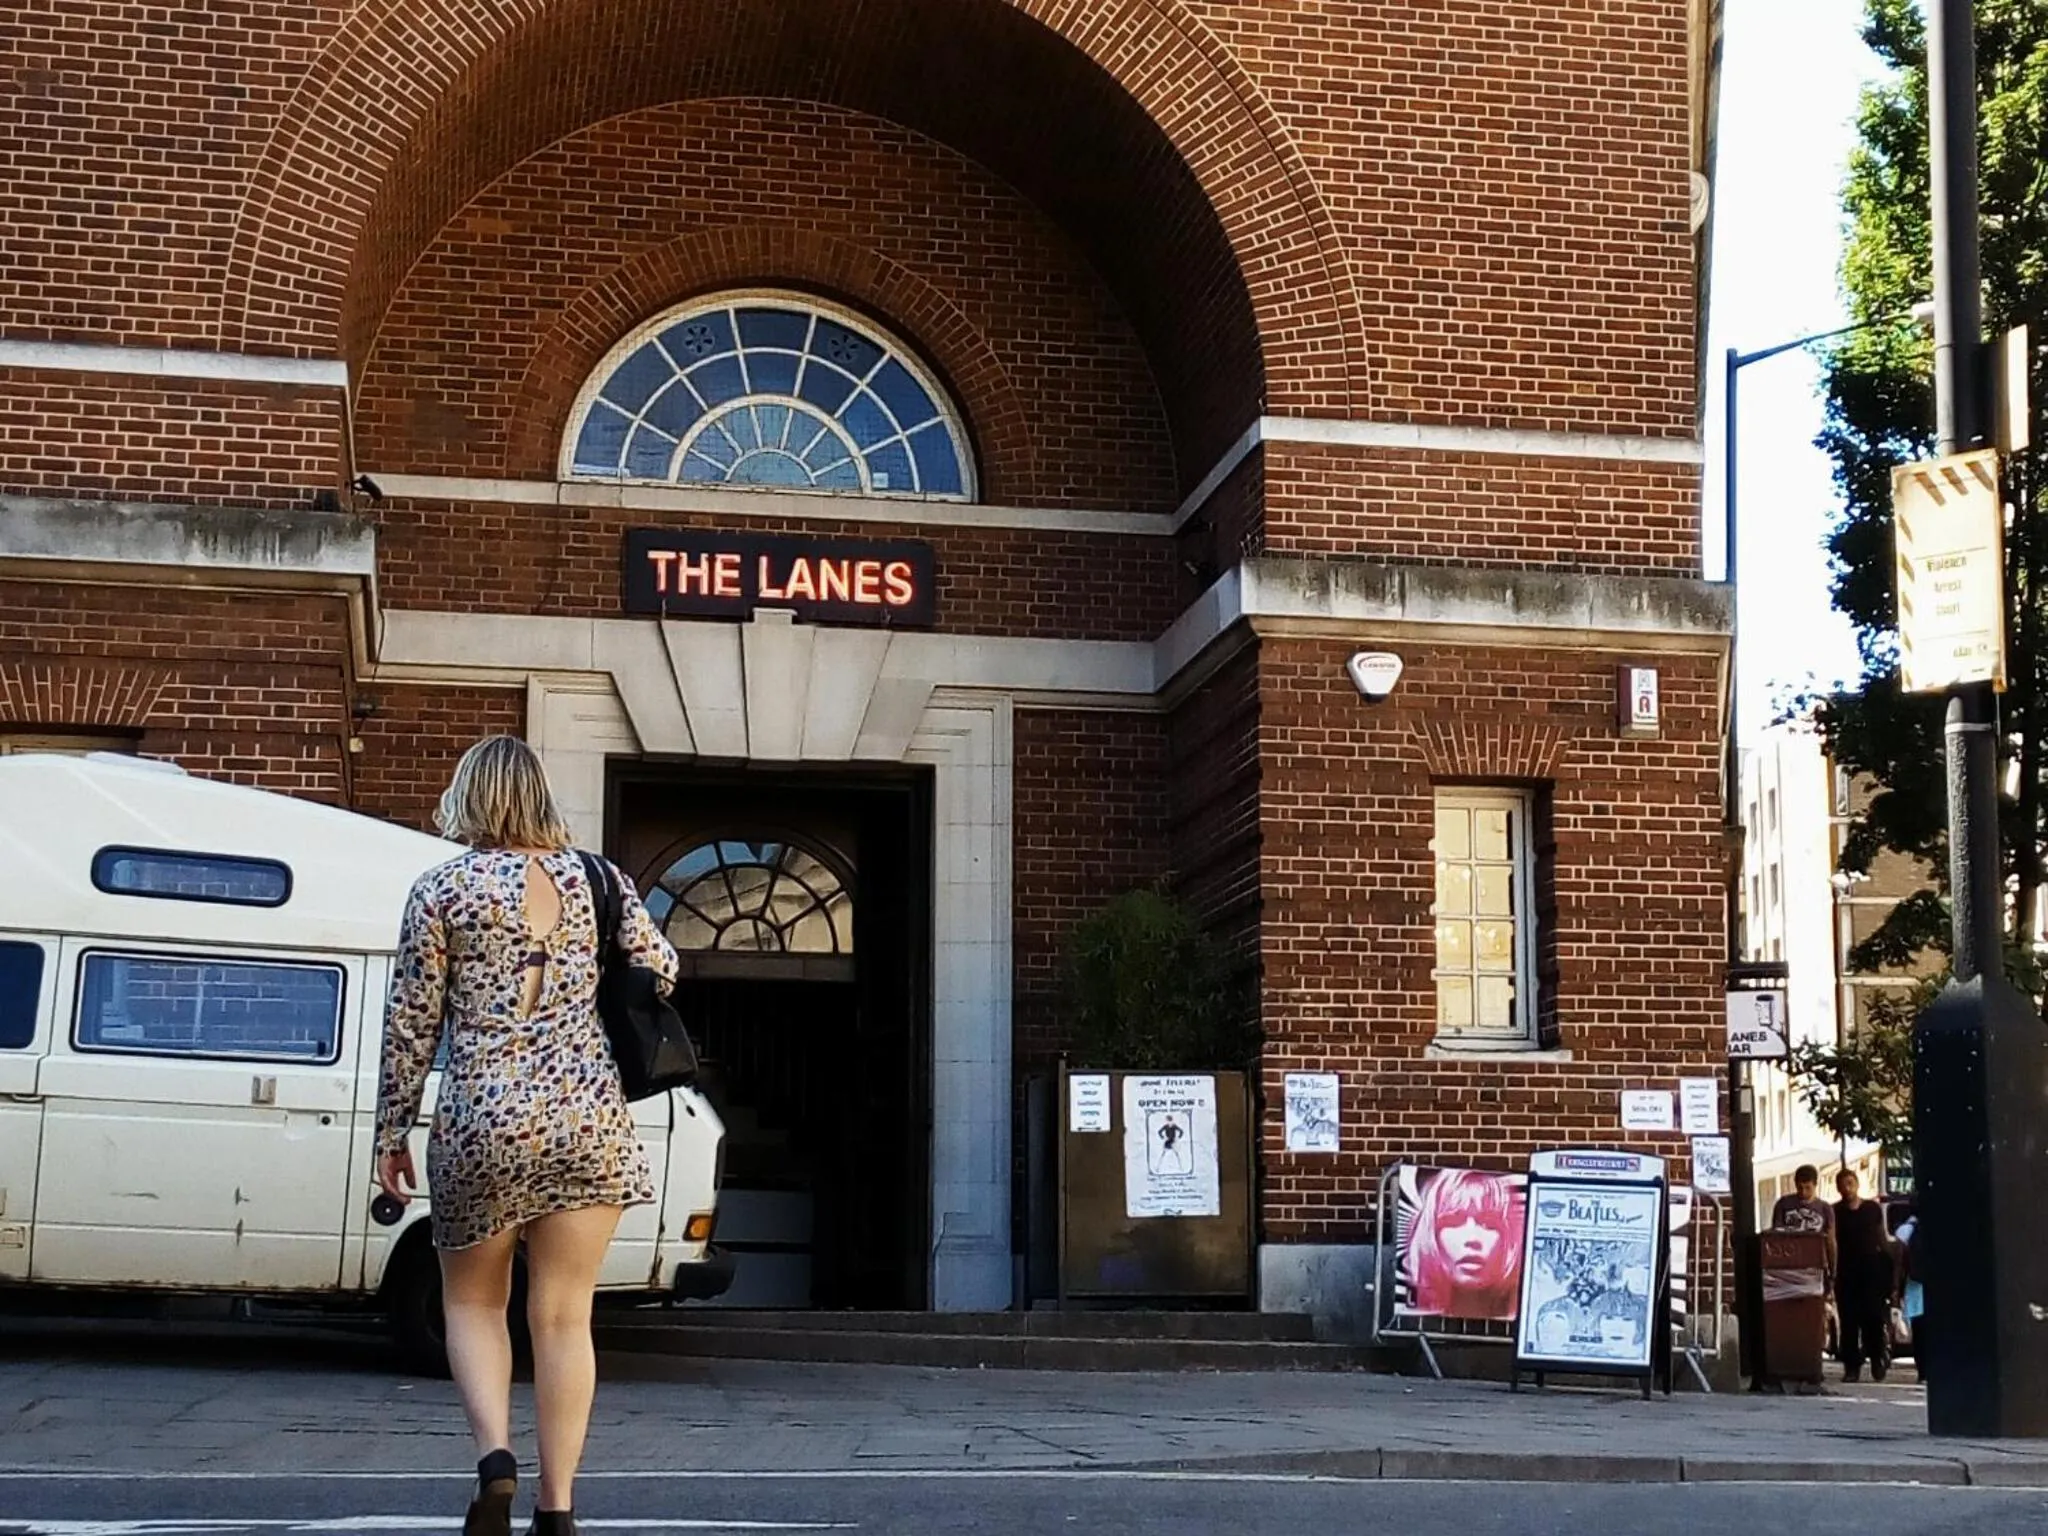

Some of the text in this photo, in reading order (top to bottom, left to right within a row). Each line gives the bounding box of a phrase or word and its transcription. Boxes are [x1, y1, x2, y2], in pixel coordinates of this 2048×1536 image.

[647, 550, 914, 605] THE LANES
[1730, 1031, 1767, 1042] ANES
[1138, 1098, 1167, 1108] OPEN
[1170, 1098, 1195, 1107] NOW
[1568, 1198, 1620, 1225] BEATLES
